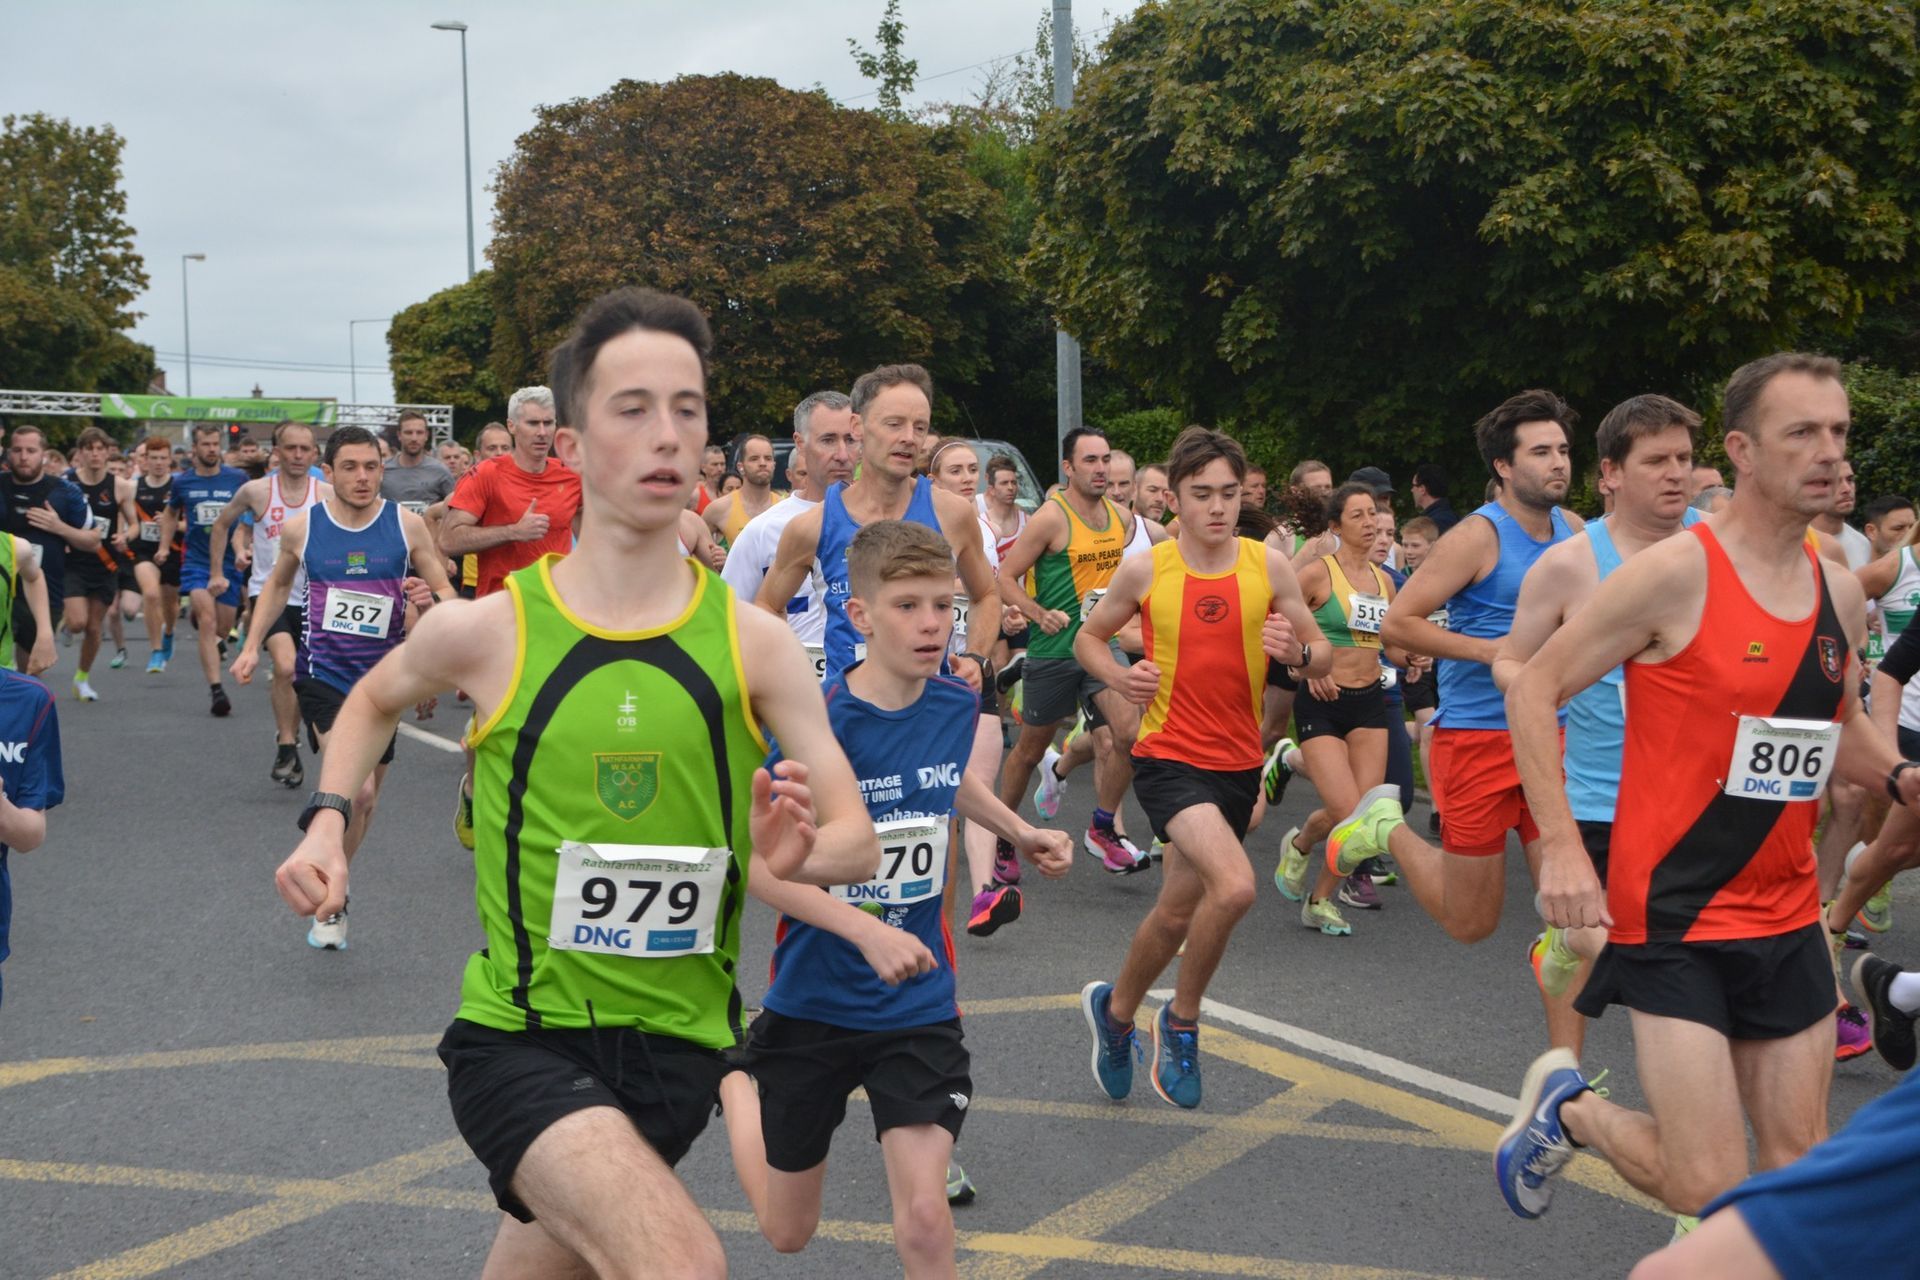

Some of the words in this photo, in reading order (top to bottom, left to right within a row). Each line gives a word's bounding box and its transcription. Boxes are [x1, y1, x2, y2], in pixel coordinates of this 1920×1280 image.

[334, 602, 382, 624] 267
[331, 620, 354, 631] DNG
[1354, 619, 1371, 629] DNG
[1750, 644, 1761, 654] IN
[1749, 741, 1824, 778] 806
[917, 762, 960, 790] DNG
[871, 787, 903, 803] UNION
[1743, 777, 1781, 795] DNG
[581, 858, 662, 873] Rathfarnham
[665, 863, 681, 873] 5k
[684, 863, 712, 873] 2022
[872, 842, 933, 880] 70
[581, 876, 700, 925] 979
[847, 884, 890, 899] DNG
[574, 924, 632, 949] DNG
